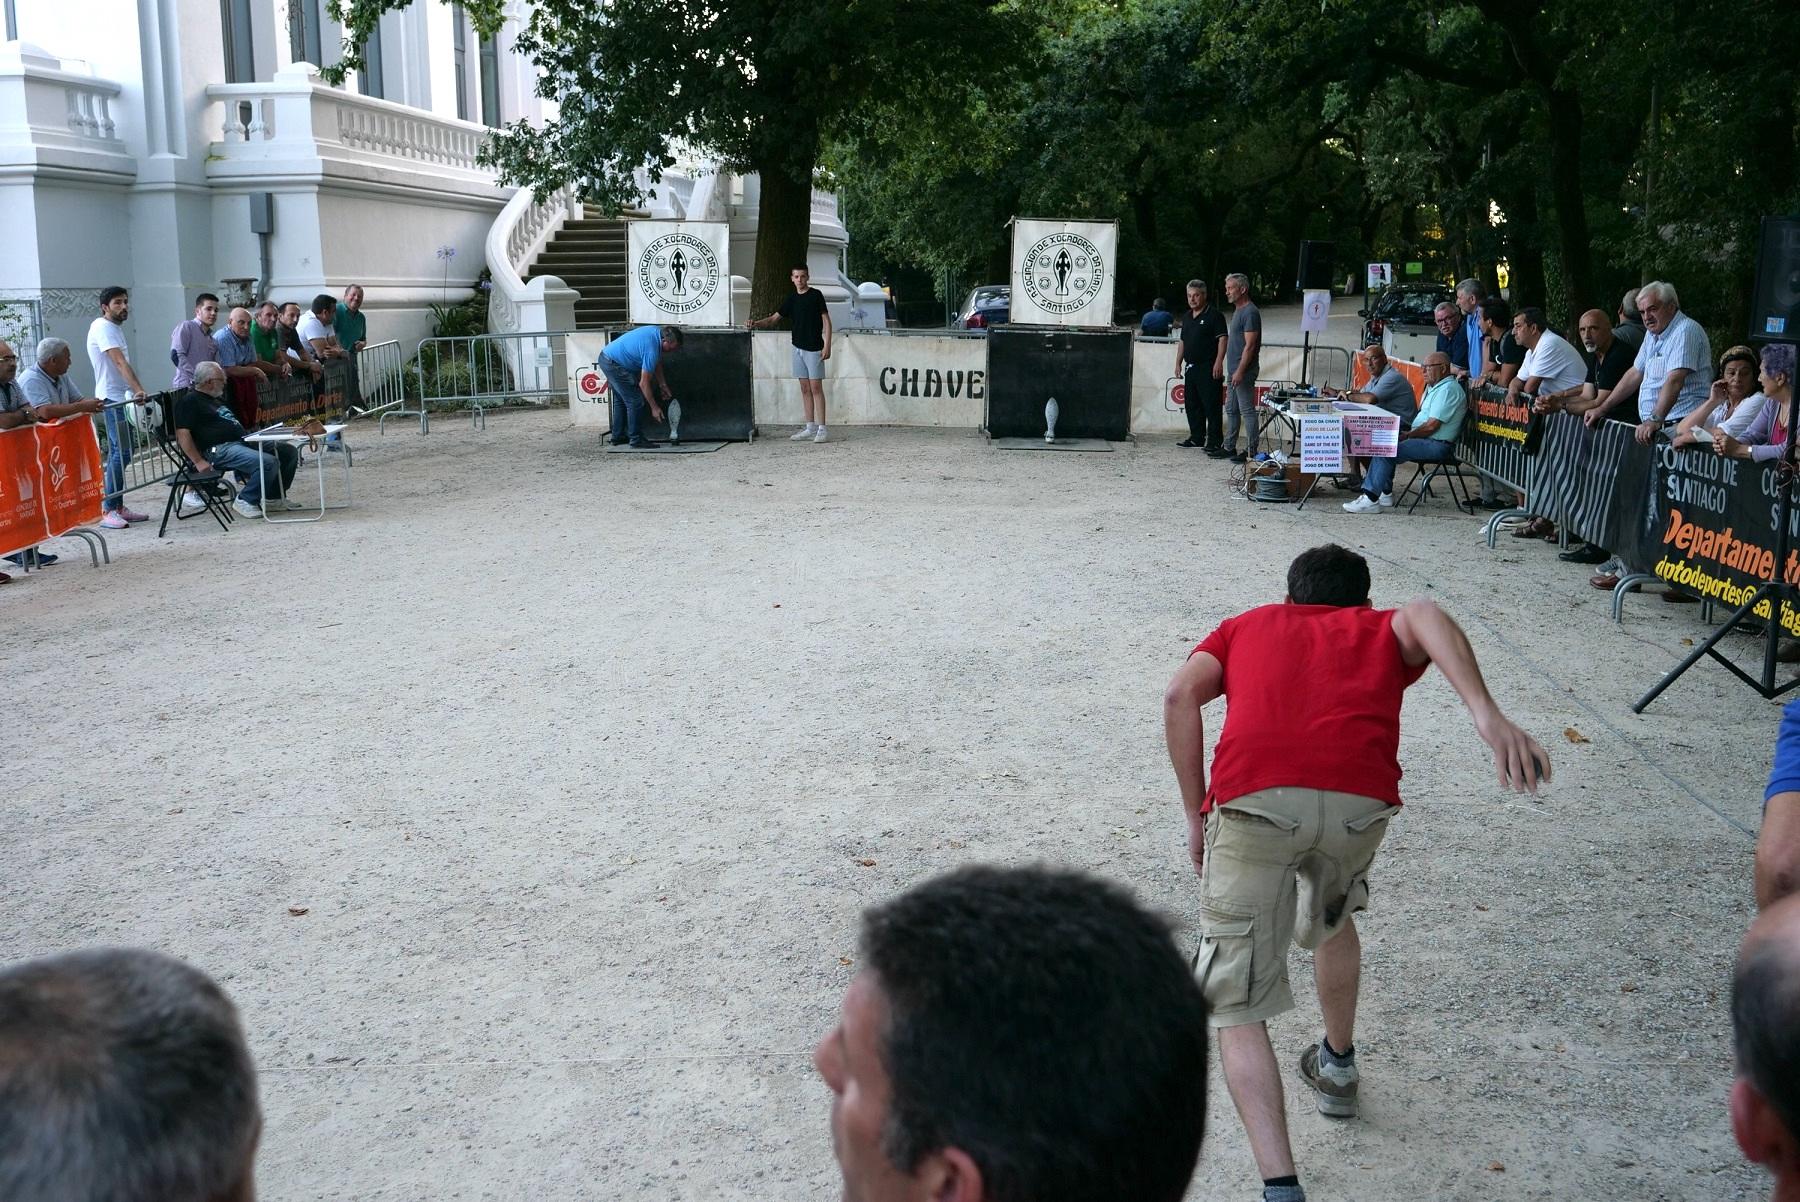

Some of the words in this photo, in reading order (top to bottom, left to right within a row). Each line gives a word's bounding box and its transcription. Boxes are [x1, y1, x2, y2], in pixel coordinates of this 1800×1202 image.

[652, 240, 664, 252] DE
[664, 235, 710, 257] XOGADORES
[1036, 240, 1049, 251] DE
[1049, 234, 1096, 256] XOGADORES
[706, 256, 716, 268] DA
[1091, 255, 1101, 267] DA
[702, 269, 718, 298] CHAVE
[1086, 269, 1102, 297] CHAVE
[658, 299, 702, 312] SANTIAGO
[1040, 299, 1085, 312] SANTIAGO
[880, 366, 985, 400] CHAVE
[1656, 443, 1719, 481] CONCELLO
[1722, 458, 1739, 487] DE
[1666, 474, 1726, 514] SANTIAGO
